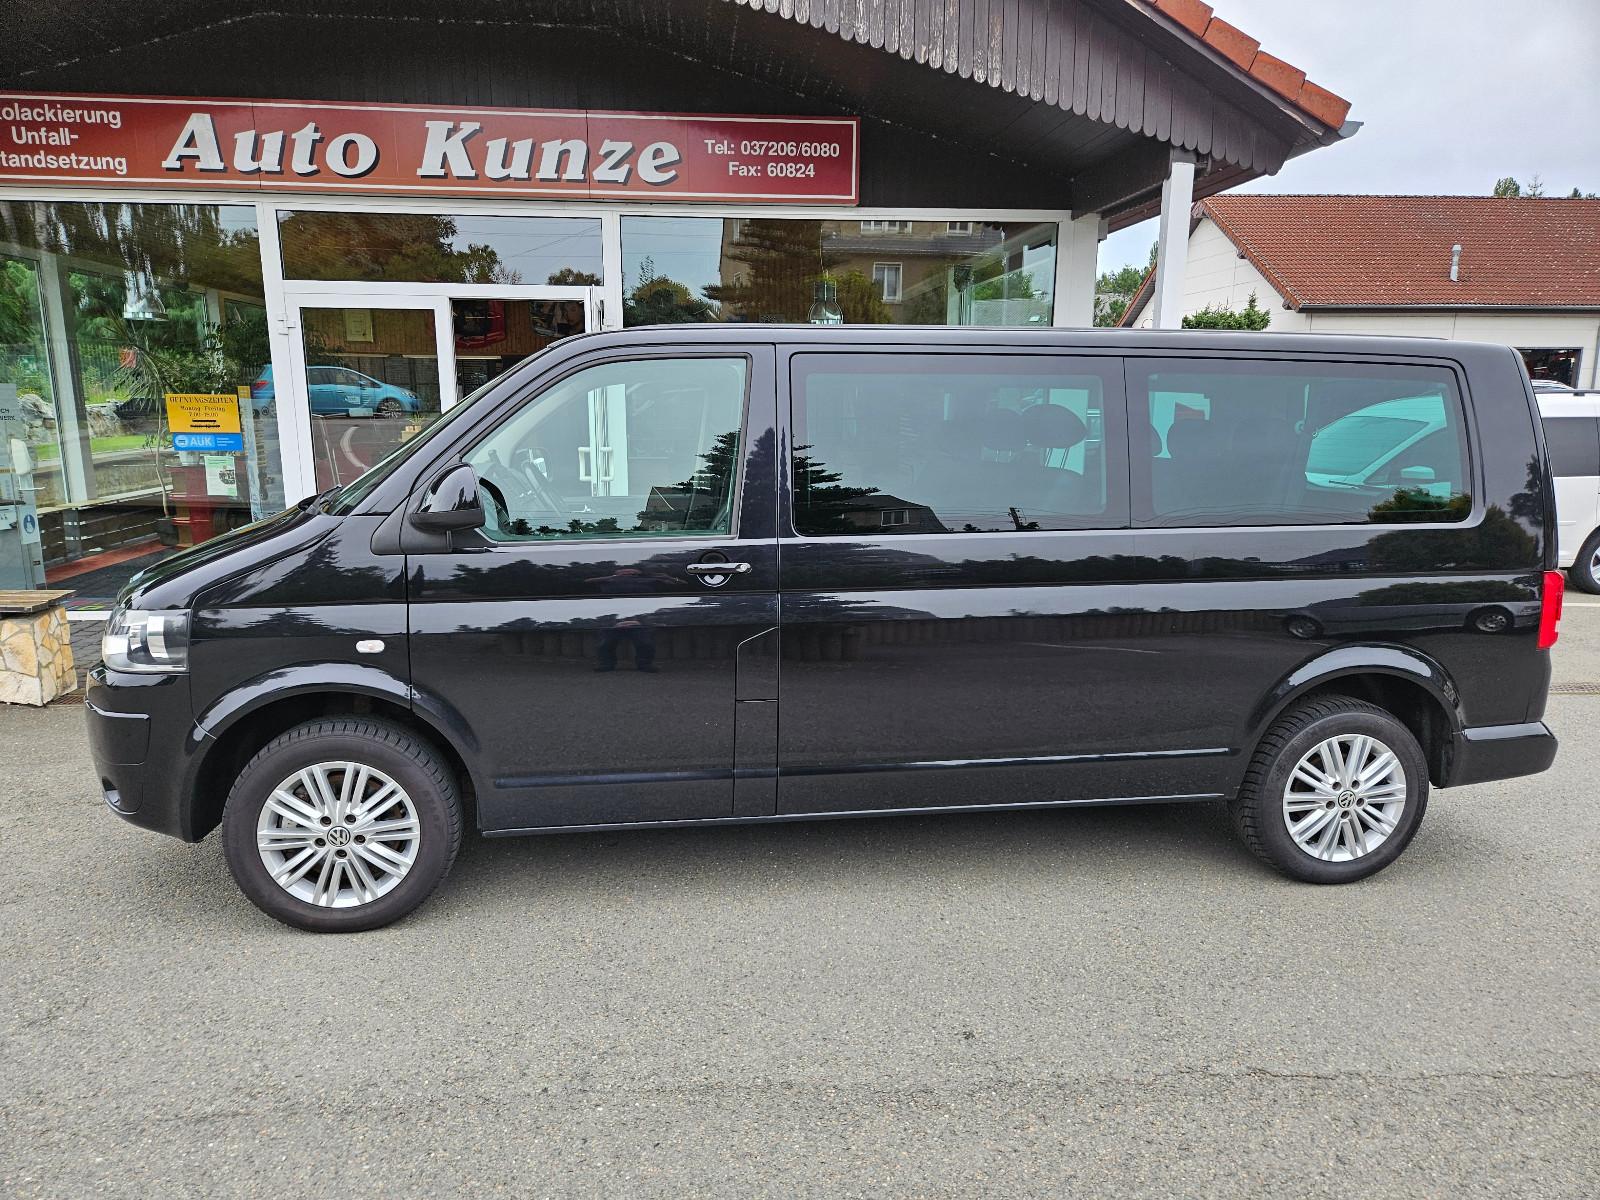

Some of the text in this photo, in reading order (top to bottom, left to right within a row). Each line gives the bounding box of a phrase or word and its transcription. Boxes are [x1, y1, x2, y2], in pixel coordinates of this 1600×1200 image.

[0, 103, 122, 129] olackierung
[11, 126, 79, 146] Unfall-
[161, 112, 682, 184] Auto Kunze
[704, 139, 840, 157] Tel.: 037206/6080
[728, 162, 815, 178] Fax: 60824
